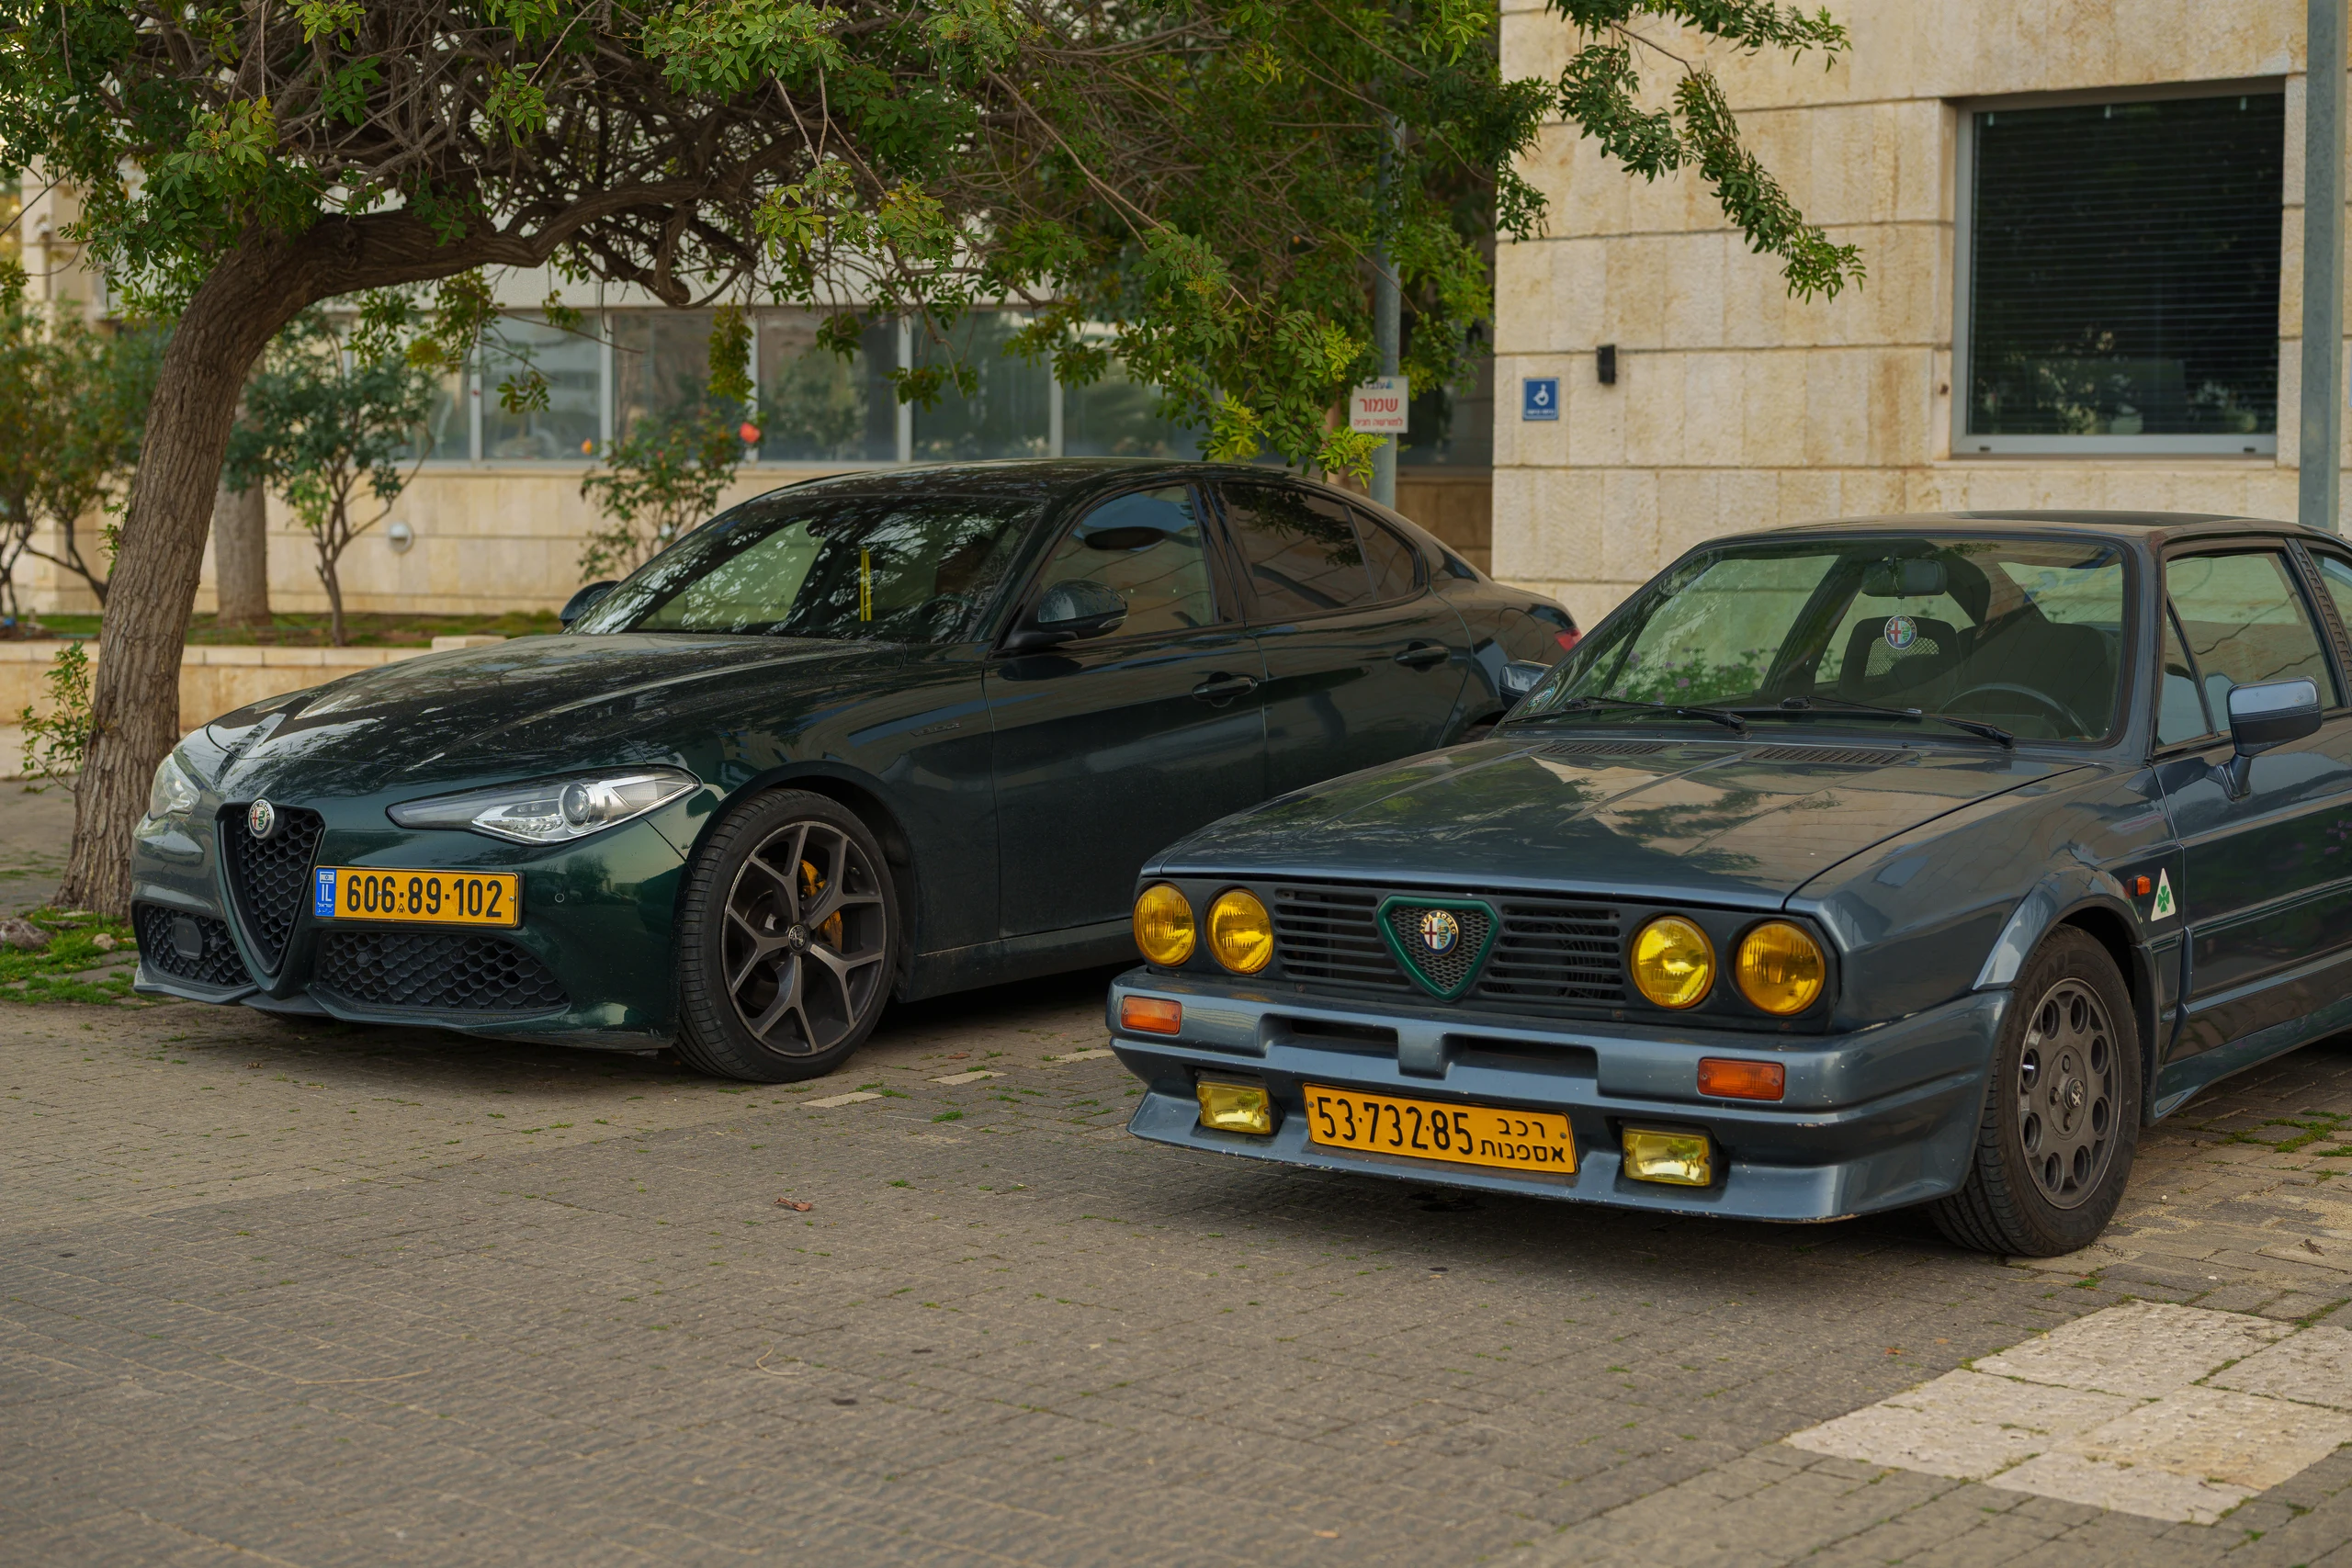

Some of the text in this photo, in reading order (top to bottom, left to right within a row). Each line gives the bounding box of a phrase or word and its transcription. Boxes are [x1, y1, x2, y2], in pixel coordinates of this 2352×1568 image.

[1359, 398, 1398, 412] שמור
[322, 884, 332, 901] IL
[1419, 911, 1456, 934] ALFA ROMEO
[1496, 1117, 1545, 1138] רכב
[1480, 1139, 1566, 1163] אספנות
